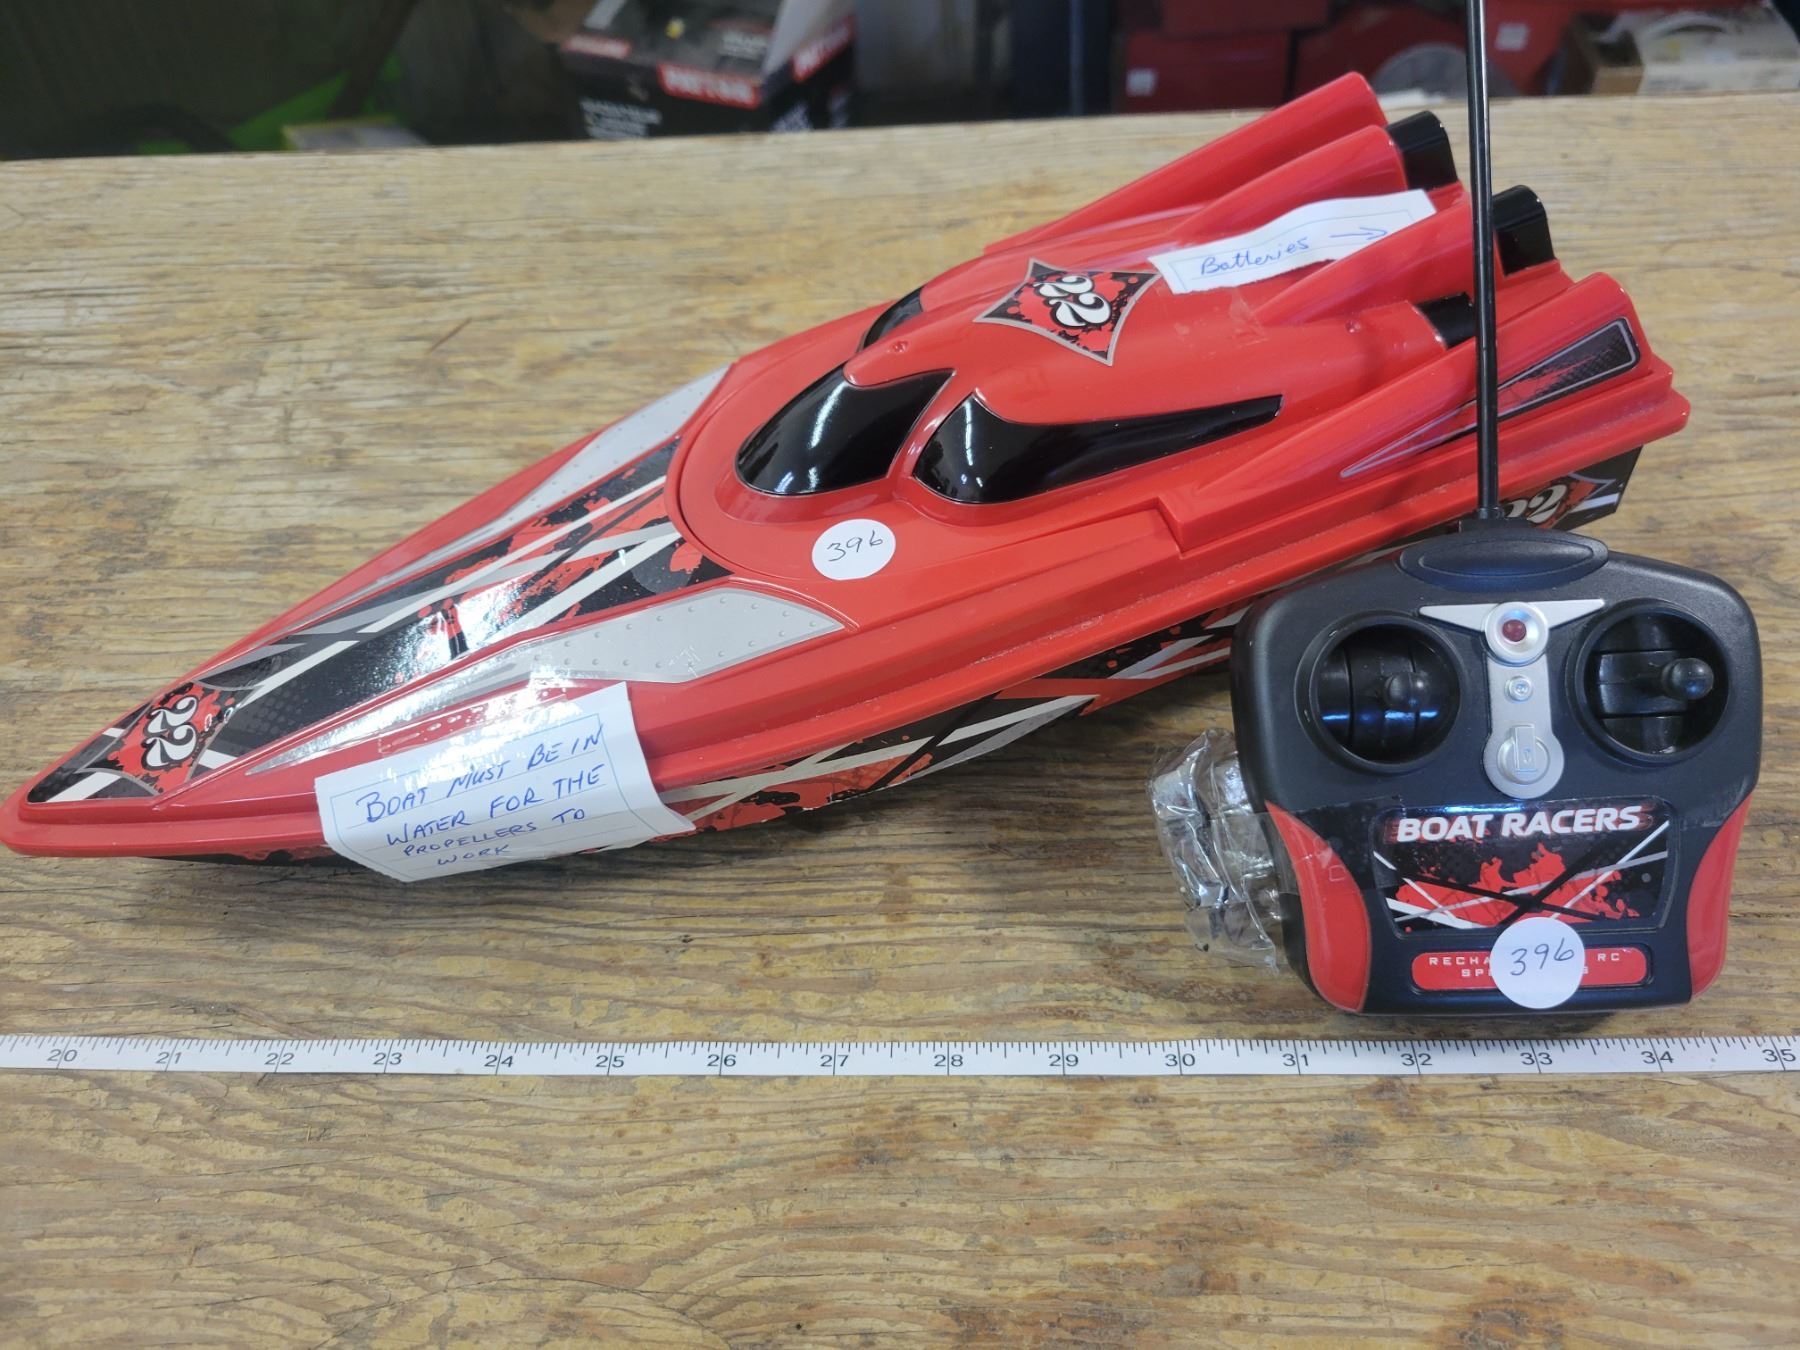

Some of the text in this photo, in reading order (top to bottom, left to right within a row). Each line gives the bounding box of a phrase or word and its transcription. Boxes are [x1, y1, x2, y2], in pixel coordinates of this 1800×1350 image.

[1200, 237, 1309, 276] Batteries
[826, 529, 883, 561] 396
[355, 786, 429, 824] BOAT
[446, 759, 510, 800] MUST
[386, 763, 605, 845] WATER FOR THE
[402, 808, 586, 857] PROPELLERS TO
[1397, 804, 1642, 842] BOAT RACERS
[438, 845, 511, 865] WORK
[1510, 936, 1575, 977] 396
[1597, 953, 1621, 962] RC
[47, 1048, 1797, 1068] 20 21 22 23 24 25 26 27 28 29 30 31 32 33 34 35
